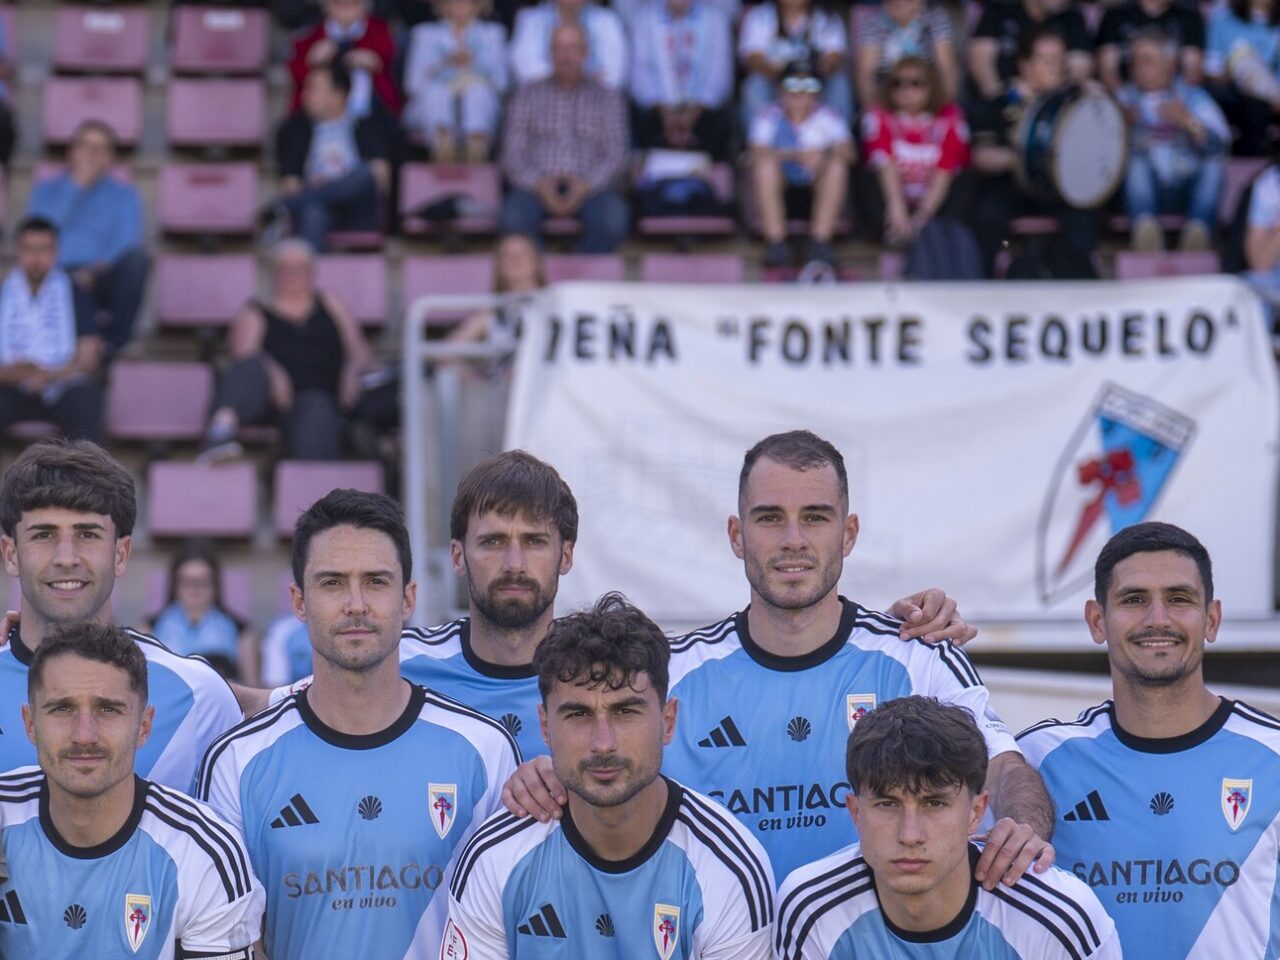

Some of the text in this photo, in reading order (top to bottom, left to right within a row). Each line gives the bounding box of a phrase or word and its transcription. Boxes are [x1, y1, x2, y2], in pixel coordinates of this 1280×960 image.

[758, 811, 827, 832] en vivo
[284, 862, 444, 899] SANTIAGO
[1072, 859, 1241, 887] SANTIAGO
[332, 892, 398, 911] en vivo
[1116, 887, 1184, 904] en vivo
